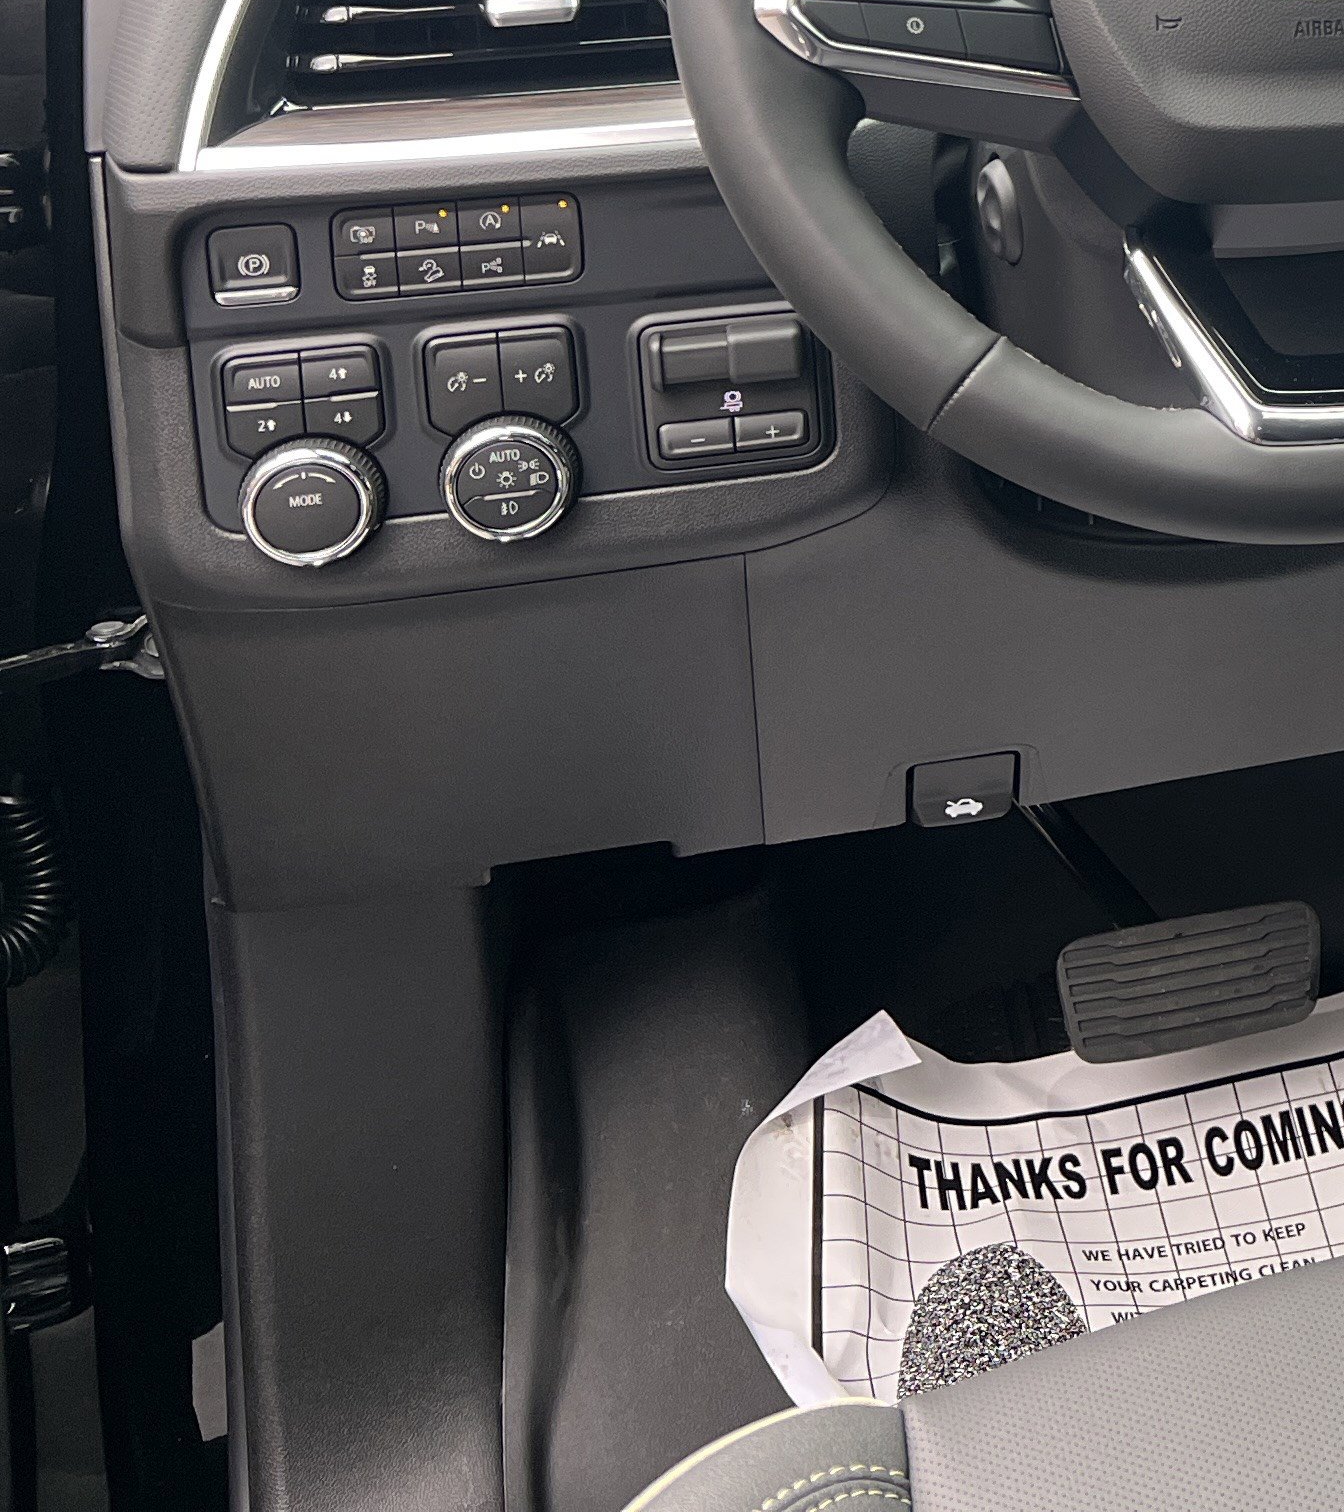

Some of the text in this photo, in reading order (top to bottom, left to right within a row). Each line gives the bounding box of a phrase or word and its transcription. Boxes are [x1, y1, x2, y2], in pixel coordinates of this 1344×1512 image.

[329, 368, 337, 380] 4
[248, 375, 281, 389] AUTO
[333, 412, 342, 424] 4
[258, 420, 266, 432] 2
[489, 449, 520, 464] AUTO
[289, 493, 322, 508] MODE
[908, 1154, 1088, 1212] THANKS
[1099, 1136, 1194, 1196] FOR
[1082, 1222, 1306, 1262] WE HAVE TRIED TO KEEP
[1091, 1279, 1144, 1293] YOUR
[1149, 1268, 1253, 1293] CARPETING
